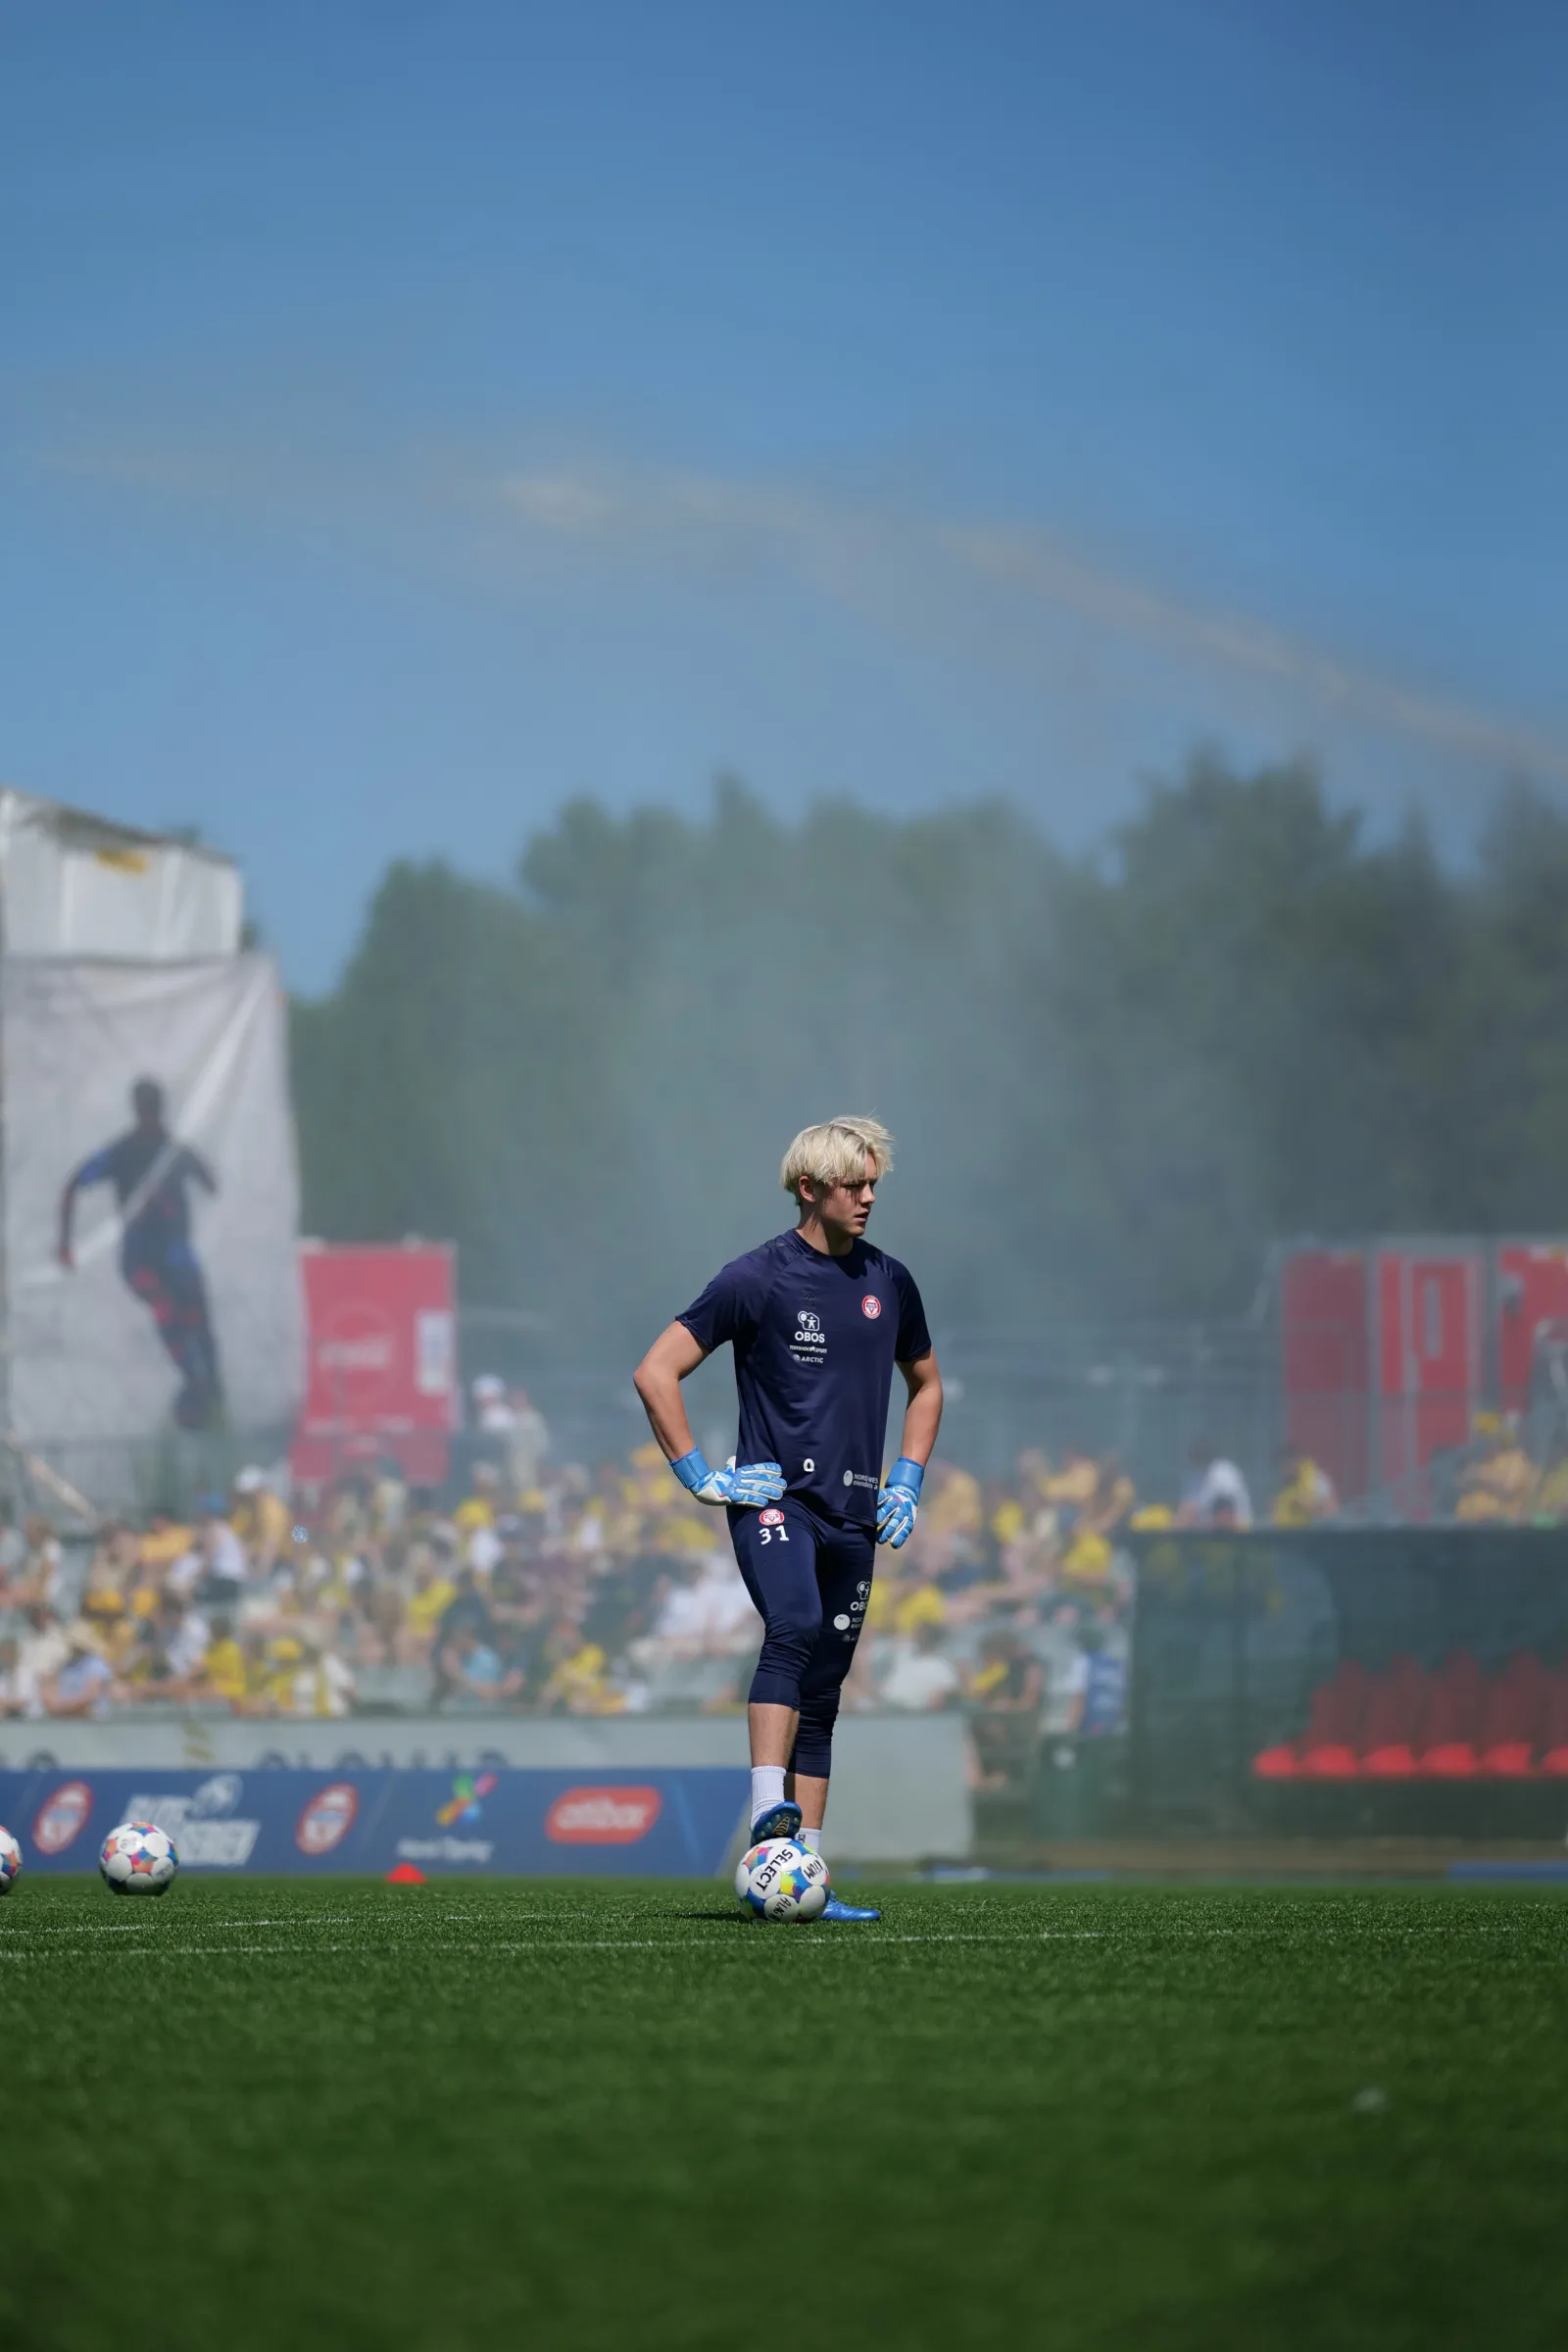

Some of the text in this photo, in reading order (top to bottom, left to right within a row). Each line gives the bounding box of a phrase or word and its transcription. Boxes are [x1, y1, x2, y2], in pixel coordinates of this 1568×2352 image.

[795, 1332, 825, 1344] OBOS
[759, 1525, 789, 1544] 31
[757, 1848, 793, 1891] SELECT
